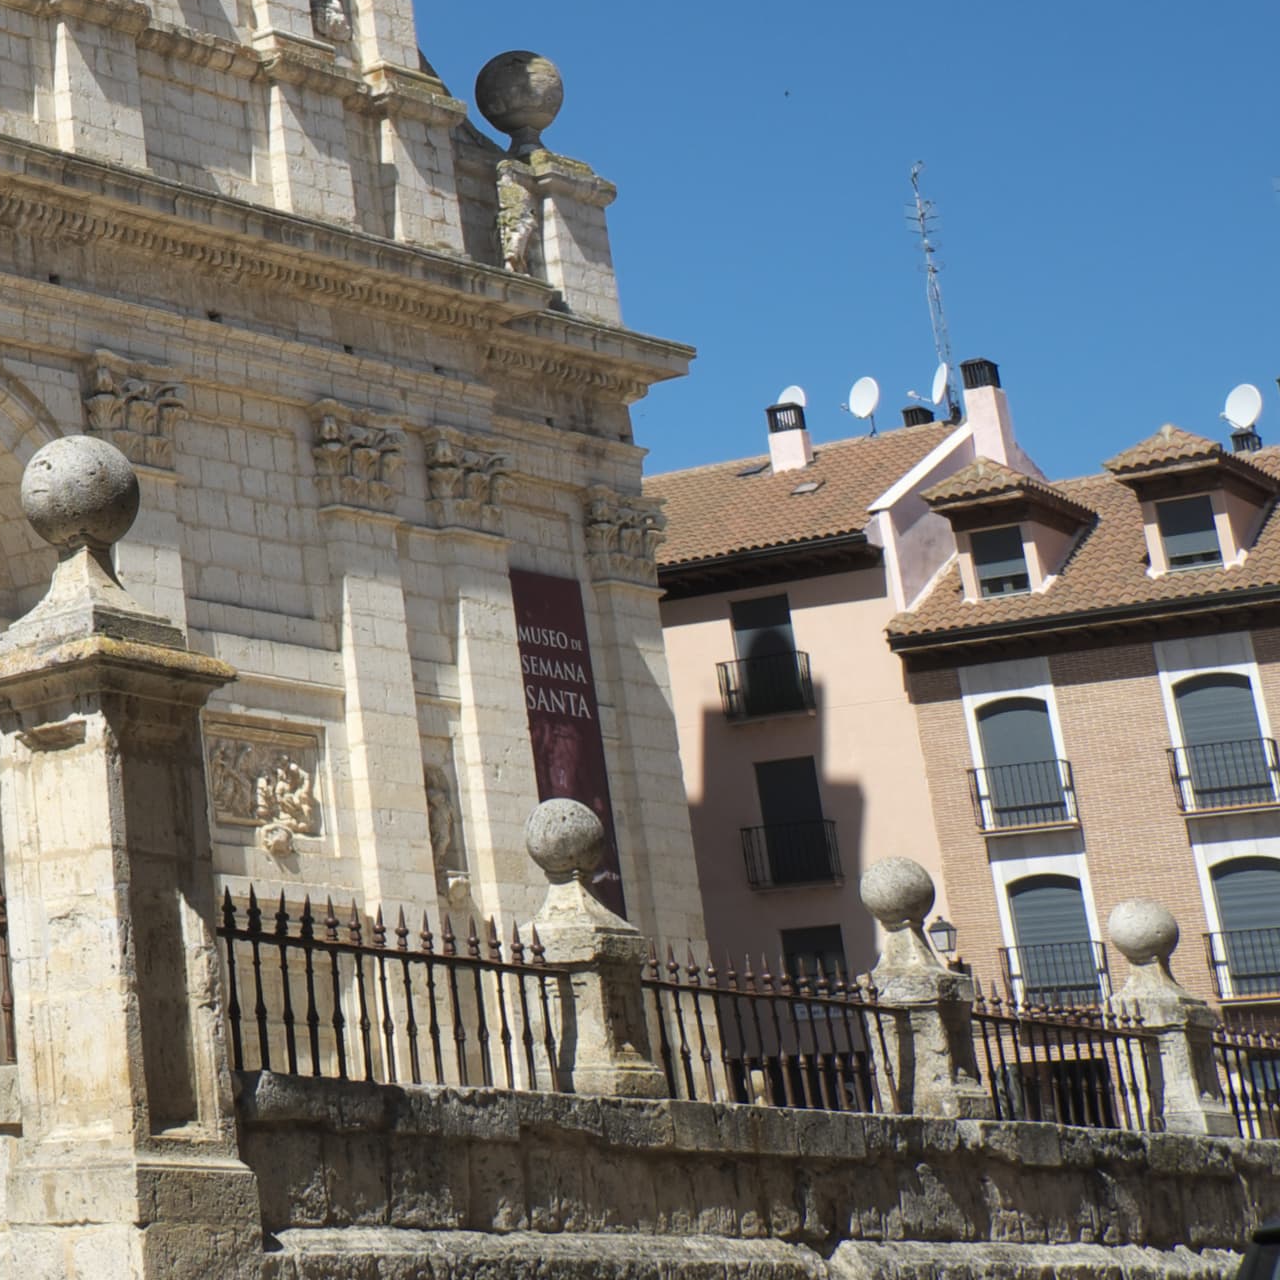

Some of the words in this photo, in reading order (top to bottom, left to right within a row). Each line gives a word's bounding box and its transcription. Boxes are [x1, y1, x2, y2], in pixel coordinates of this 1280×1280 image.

[518, 624, 568, 649] MUSEO
[521, 654, 587, 684] SEMANA
[526, 685, 592, 719] SANTA
